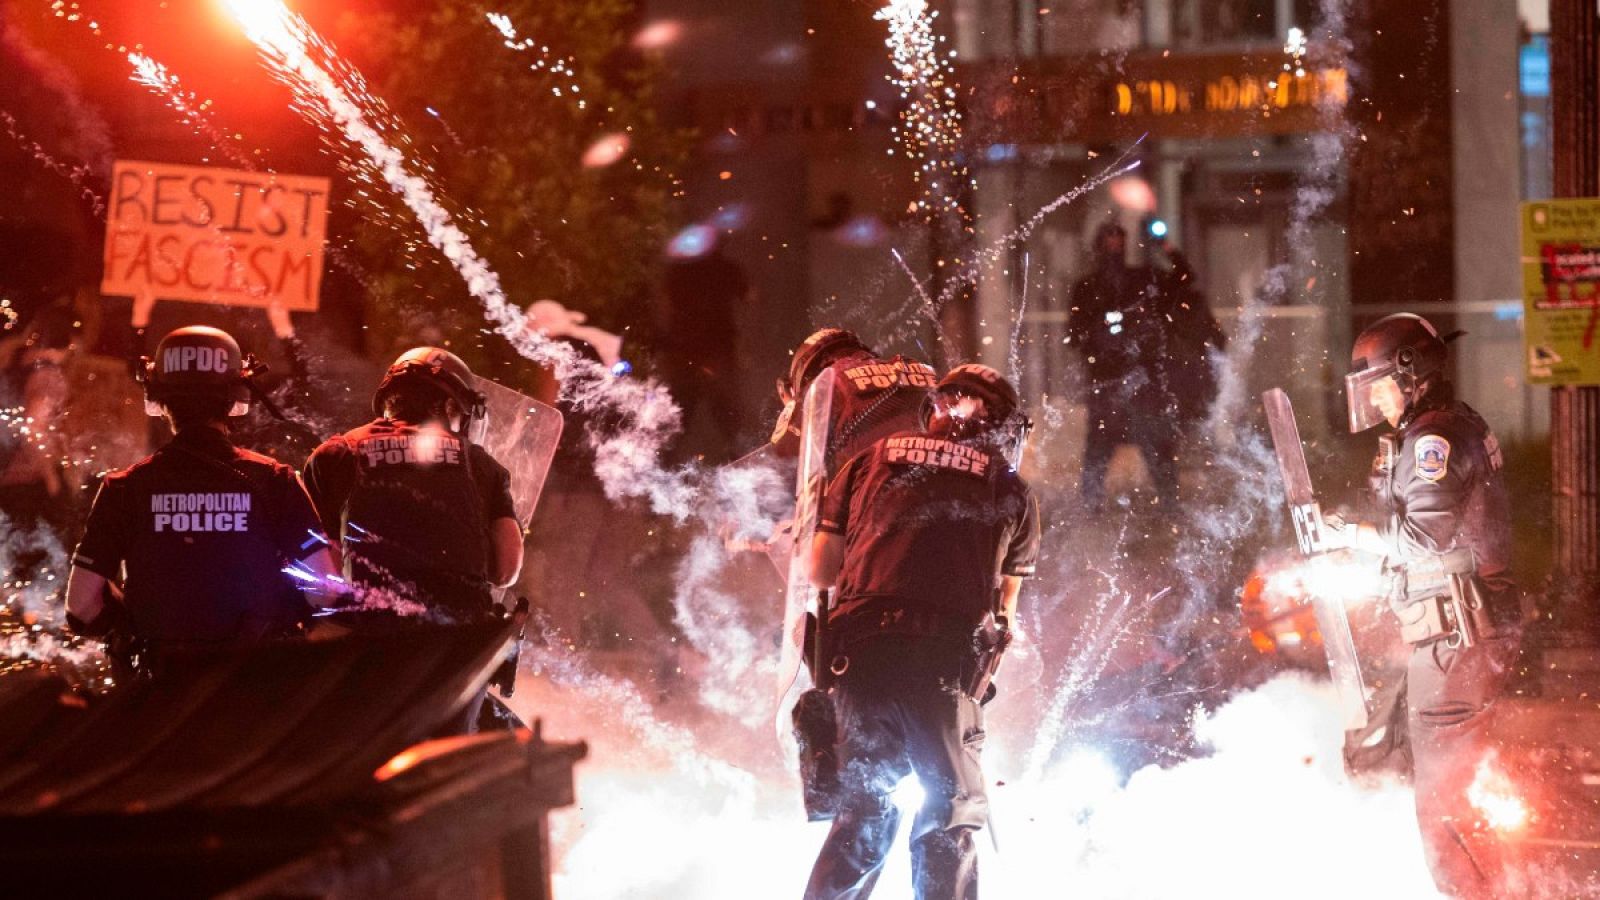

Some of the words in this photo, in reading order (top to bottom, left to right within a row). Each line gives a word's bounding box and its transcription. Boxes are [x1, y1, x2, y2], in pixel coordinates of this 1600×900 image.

[114, 170, 325, 238] RESIST
[106, 230, 314, 302] FASCISM
[163, 347, 229, 373] MPDC
[886, 437, 989, 465] METROPOLITAN
[887, 448, 985, 476] POLICE
[151, 493, 250, 513] METROPOLITAN
[154, 512, 248, 532] POLICE
